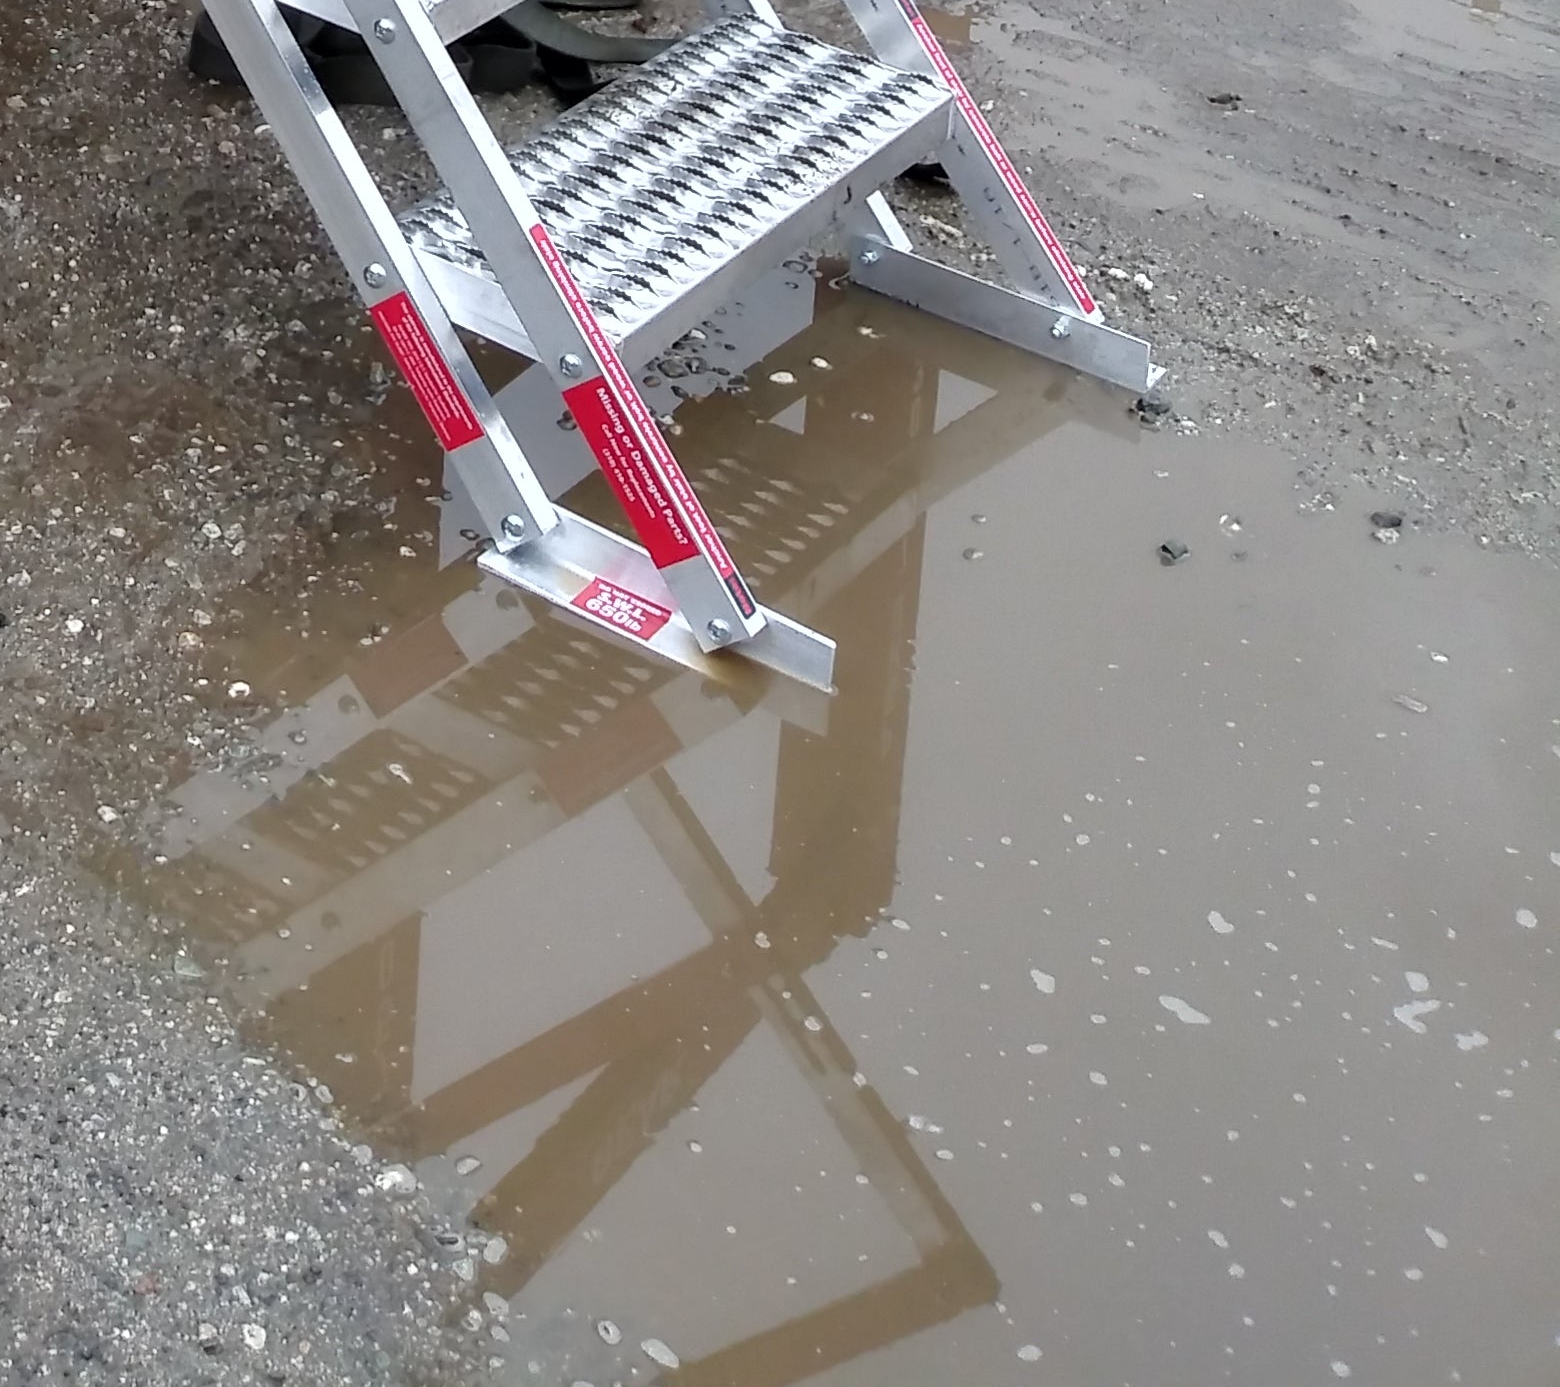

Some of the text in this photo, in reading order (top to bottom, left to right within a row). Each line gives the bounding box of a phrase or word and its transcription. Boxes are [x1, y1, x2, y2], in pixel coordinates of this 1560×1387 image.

[594, 386, 688, 547] Missing or Damaged Parts?
